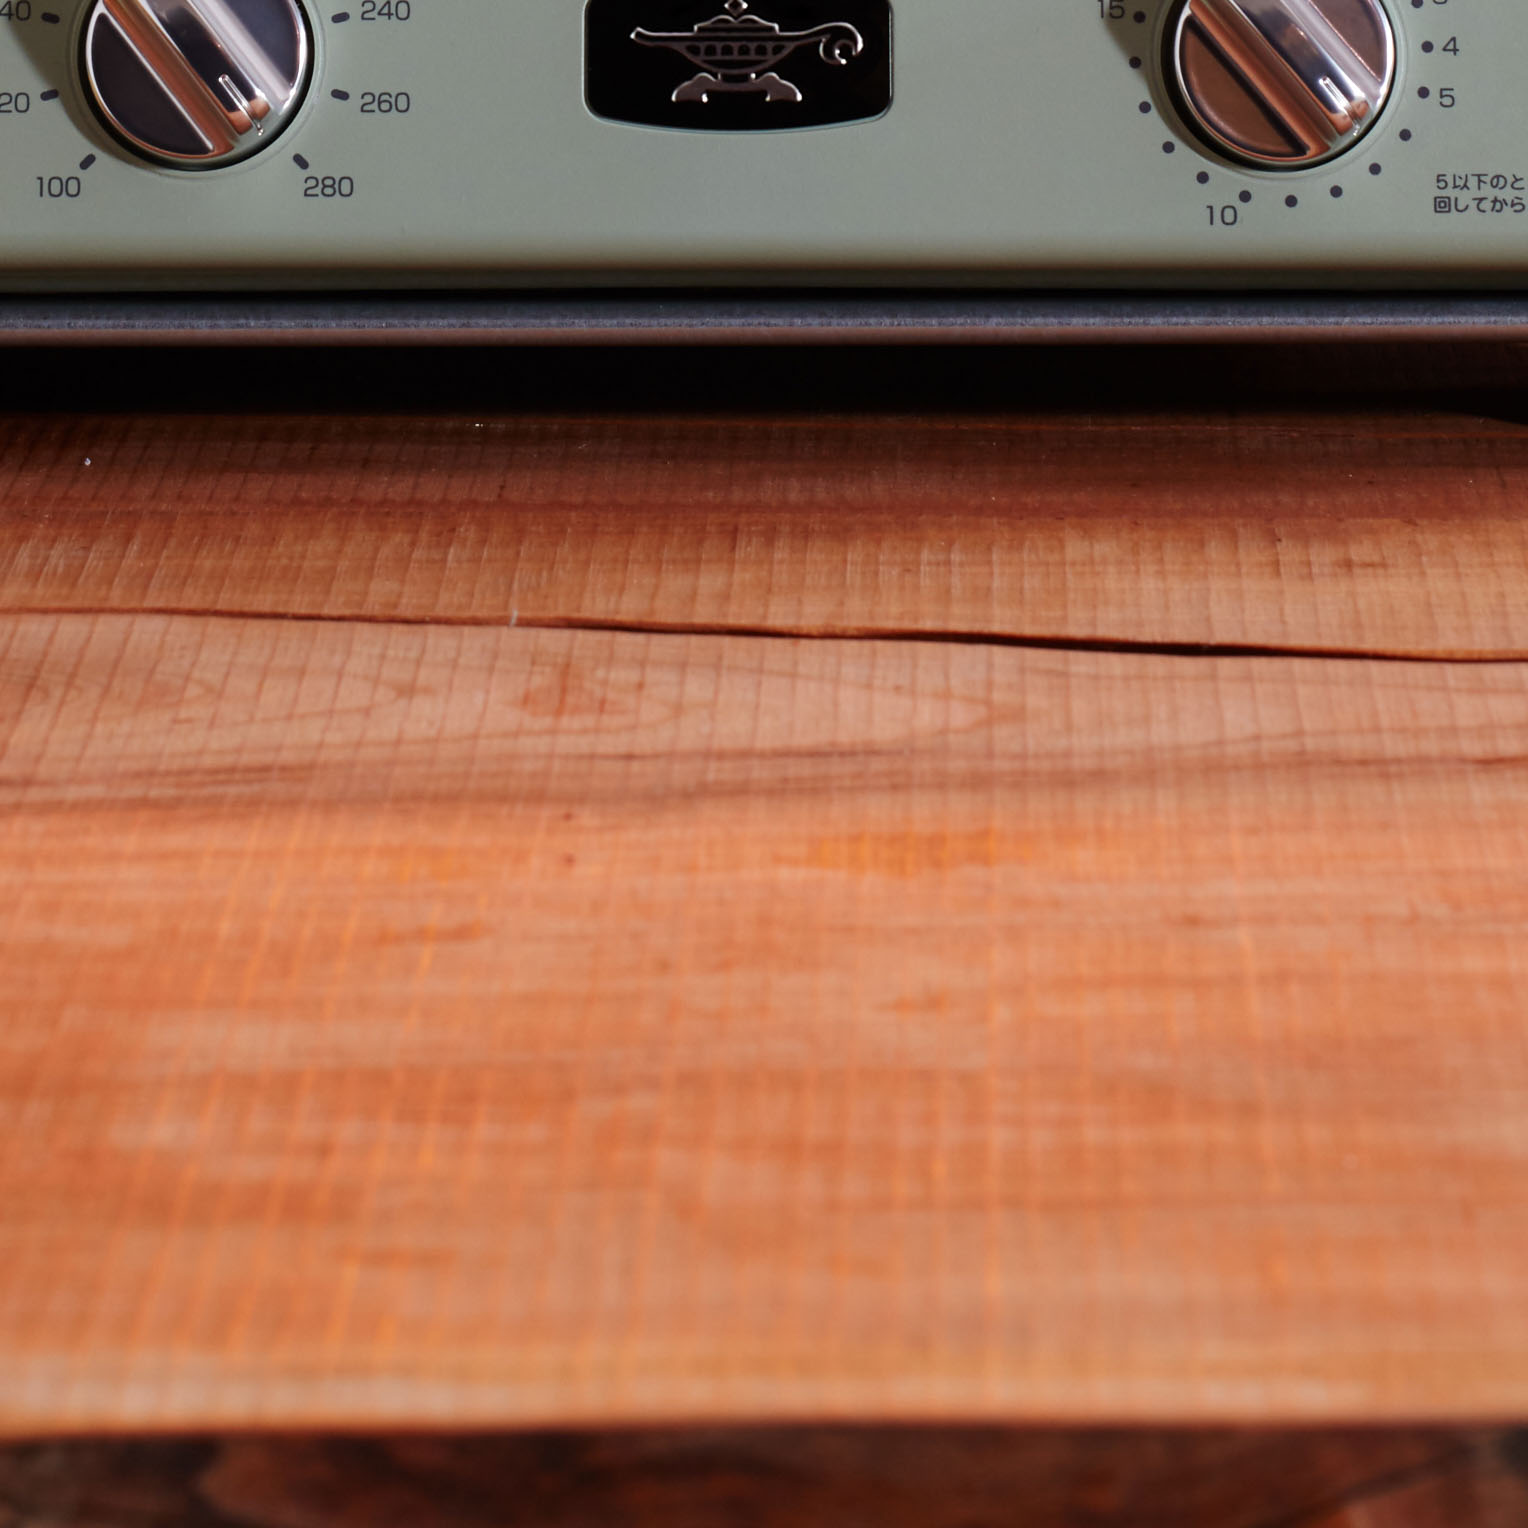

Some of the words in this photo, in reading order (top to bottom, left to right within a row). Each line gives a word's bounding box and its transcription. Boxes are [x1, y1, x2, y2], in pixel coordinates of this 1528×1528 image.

[360, 0, 411, 22] 240
[1441, 36, 1460, 57] 4
[359, 91, 411, 114] 260
[1439, 87, 1456, 109] 5
[36, 175, 81, 199] 100
[303, 175, 354, 198] 280
[1205, 204, 1237, 226] 10
